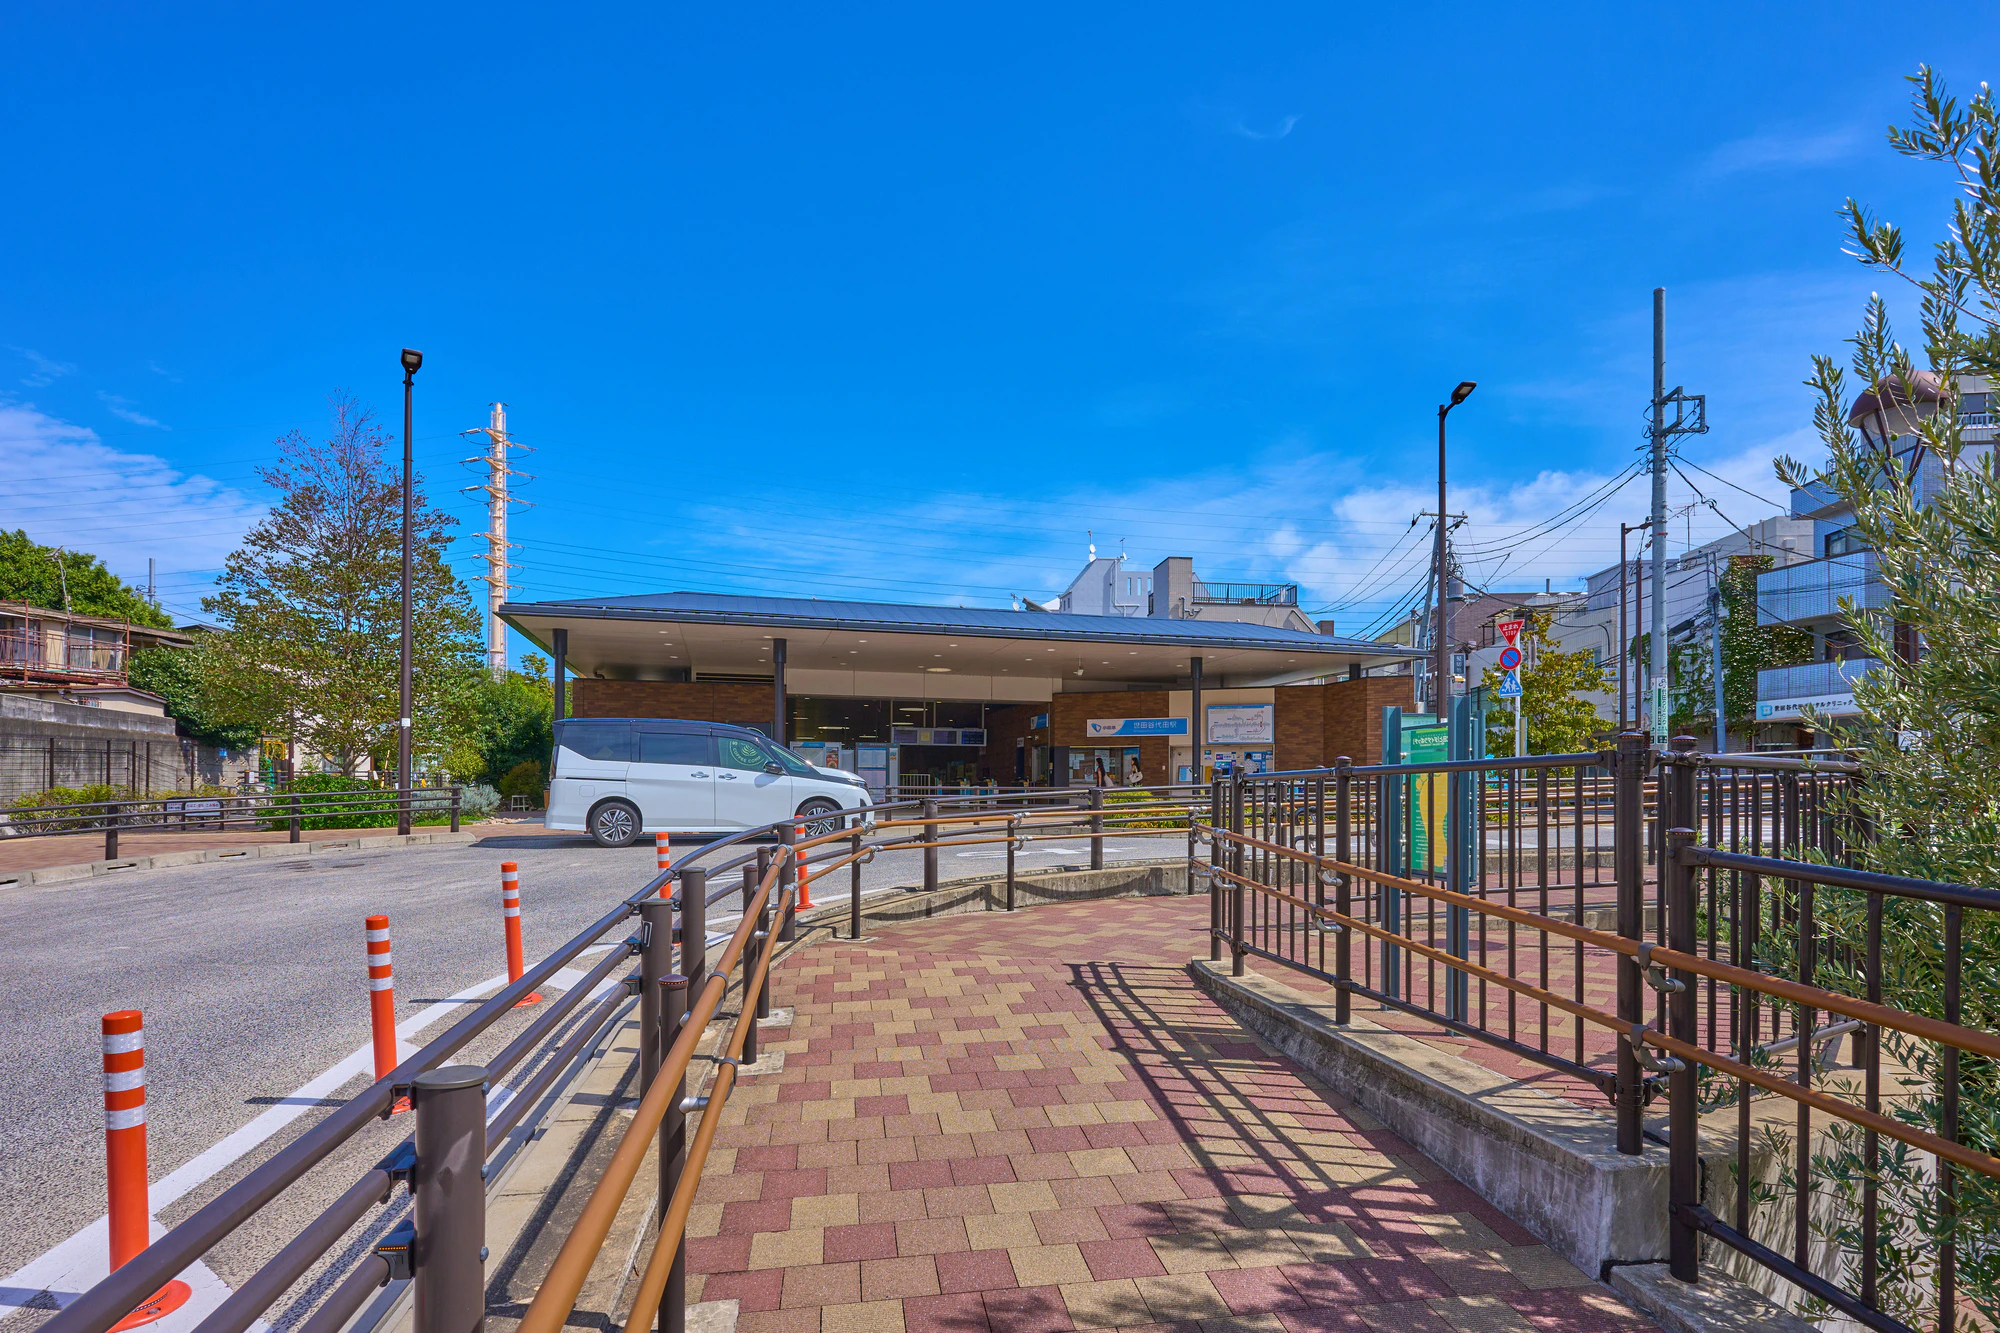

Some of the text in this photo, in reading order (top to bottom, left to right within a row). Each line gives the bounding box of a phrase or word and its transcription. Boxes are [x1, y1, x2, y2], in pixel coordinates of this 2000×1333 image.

[1502, 623, 1518, 631] 止まれ
[1133, 721, 1177, 729] 世田谷代田駅
